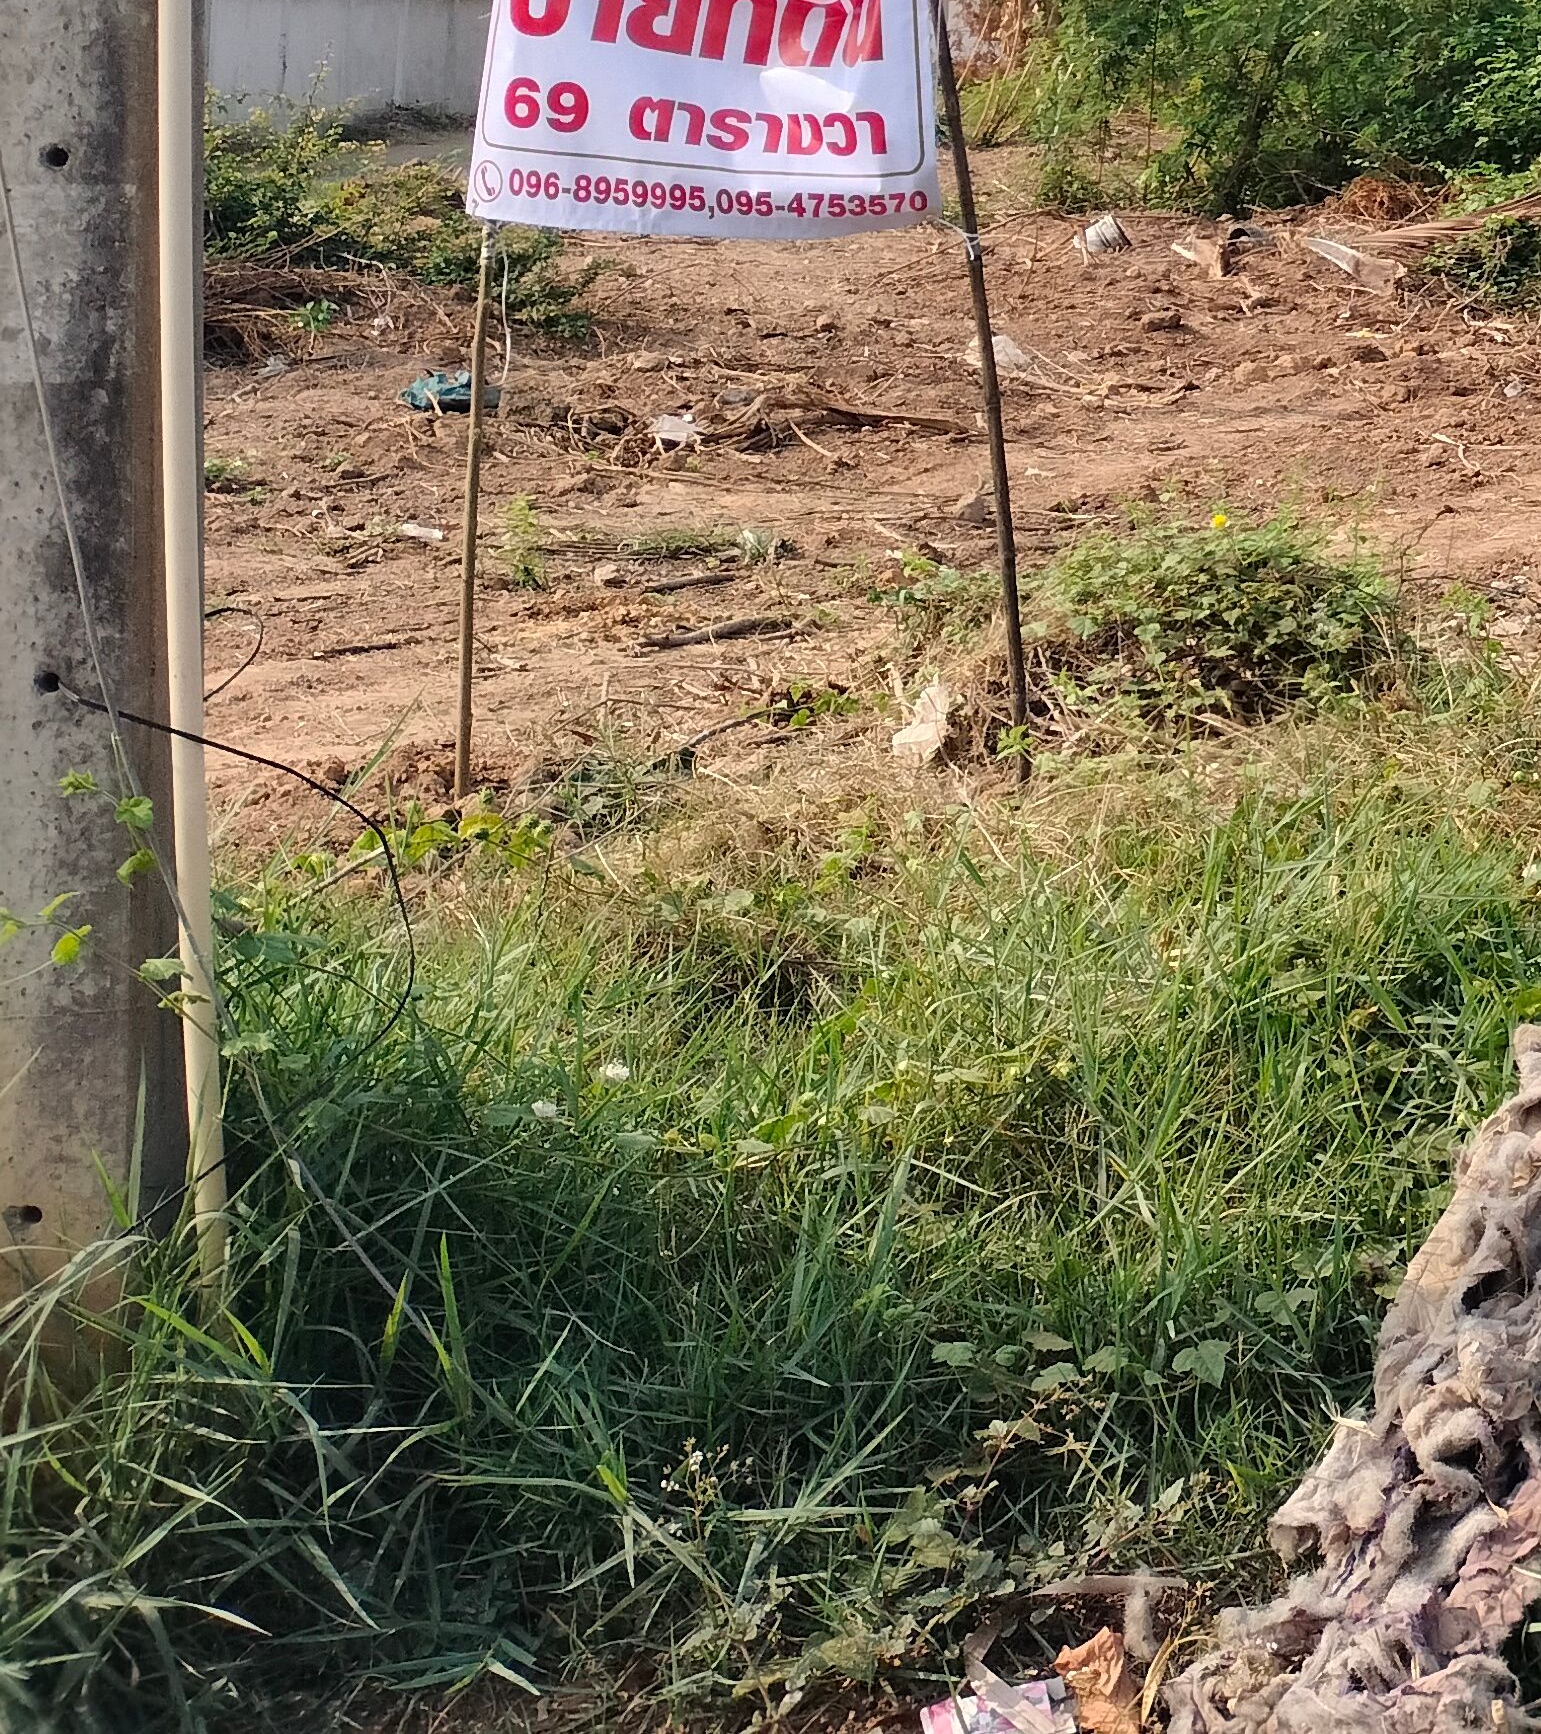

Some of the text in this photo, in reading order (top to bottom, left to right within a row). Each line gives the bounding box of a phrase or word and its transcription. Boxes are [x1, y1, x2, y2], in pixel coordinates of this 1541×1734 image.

[504, 77, 888, 155] 69 ตารางวา
[508, 168, 928, 220] 096-8959995,095-4753570
